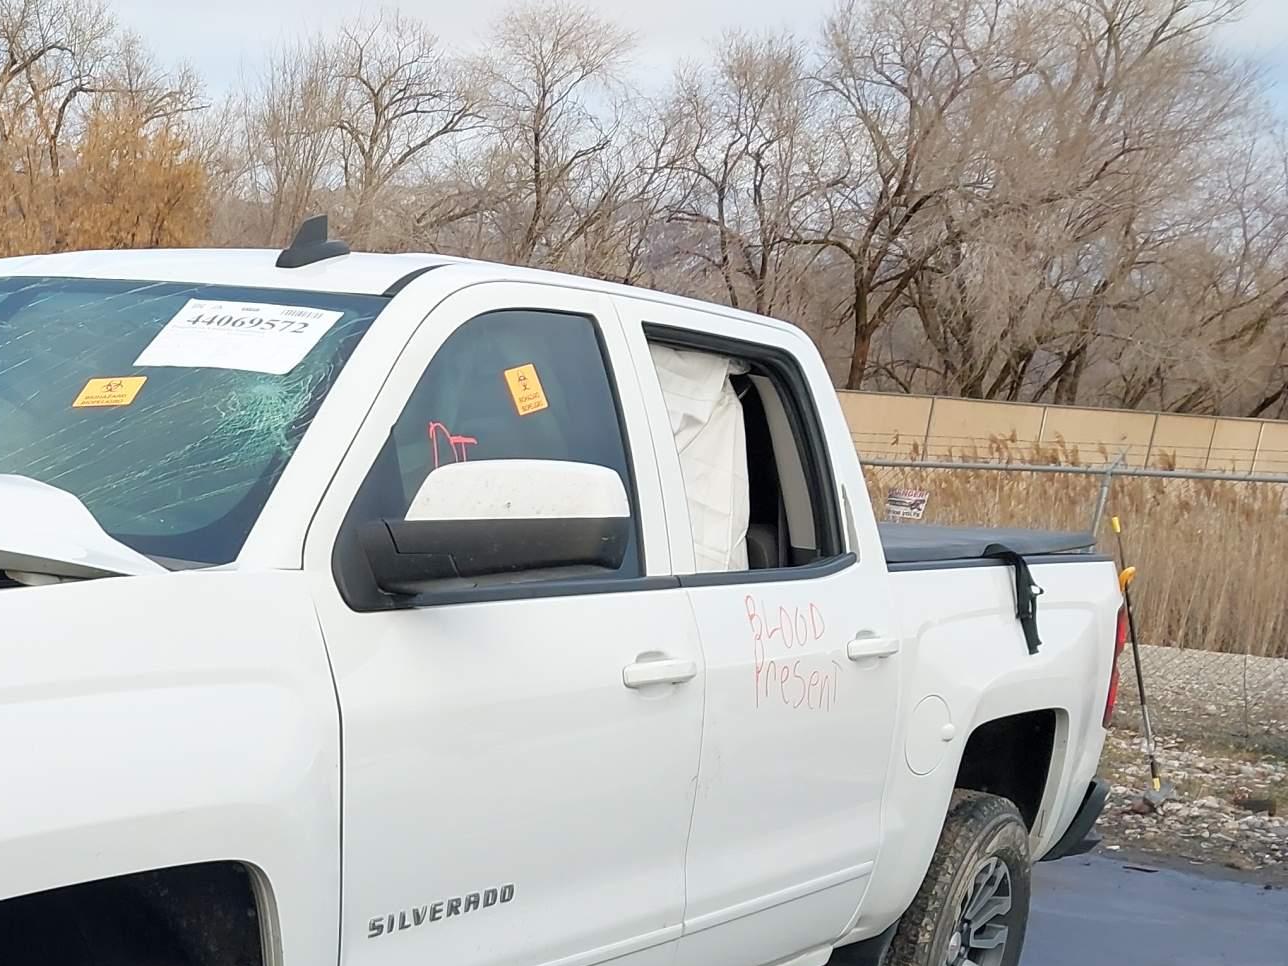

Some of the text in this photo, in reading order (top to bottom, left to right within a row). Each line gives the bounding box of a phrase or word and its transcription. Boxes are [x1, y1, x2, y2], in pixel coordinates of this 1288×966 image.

[186, 313, 310, 334] 44069572
[744, 595, 826, 649] BLOOD
[367, 883, 515, 939] SILVERADO
